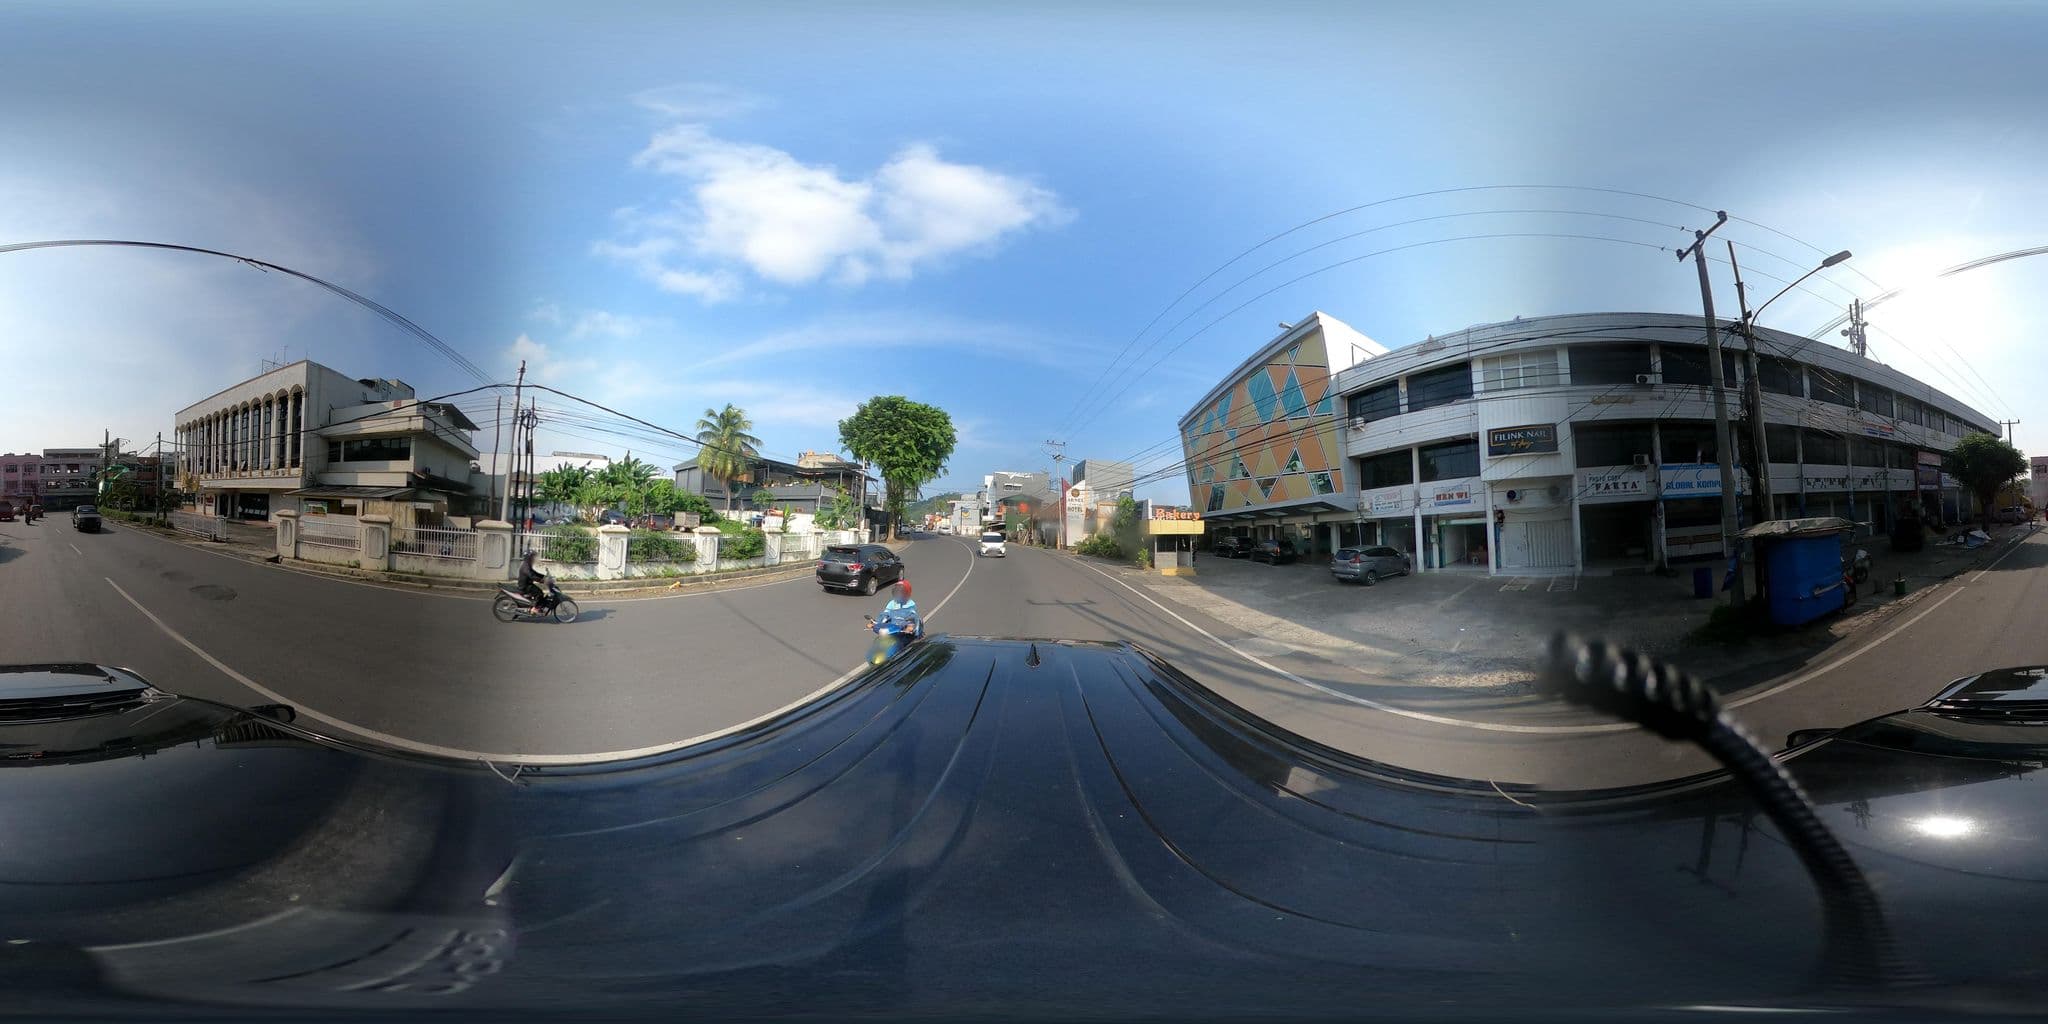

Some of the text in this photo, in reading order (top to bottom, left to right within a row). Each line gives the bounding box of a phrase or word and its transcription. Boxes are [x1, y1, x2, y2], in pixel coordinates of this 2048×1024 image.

[1494, 431, 1524, 441] FILINK
[1665, 480, 1695, 490] GLOBAL
[1155, 508, 1200, 521] Bakery
